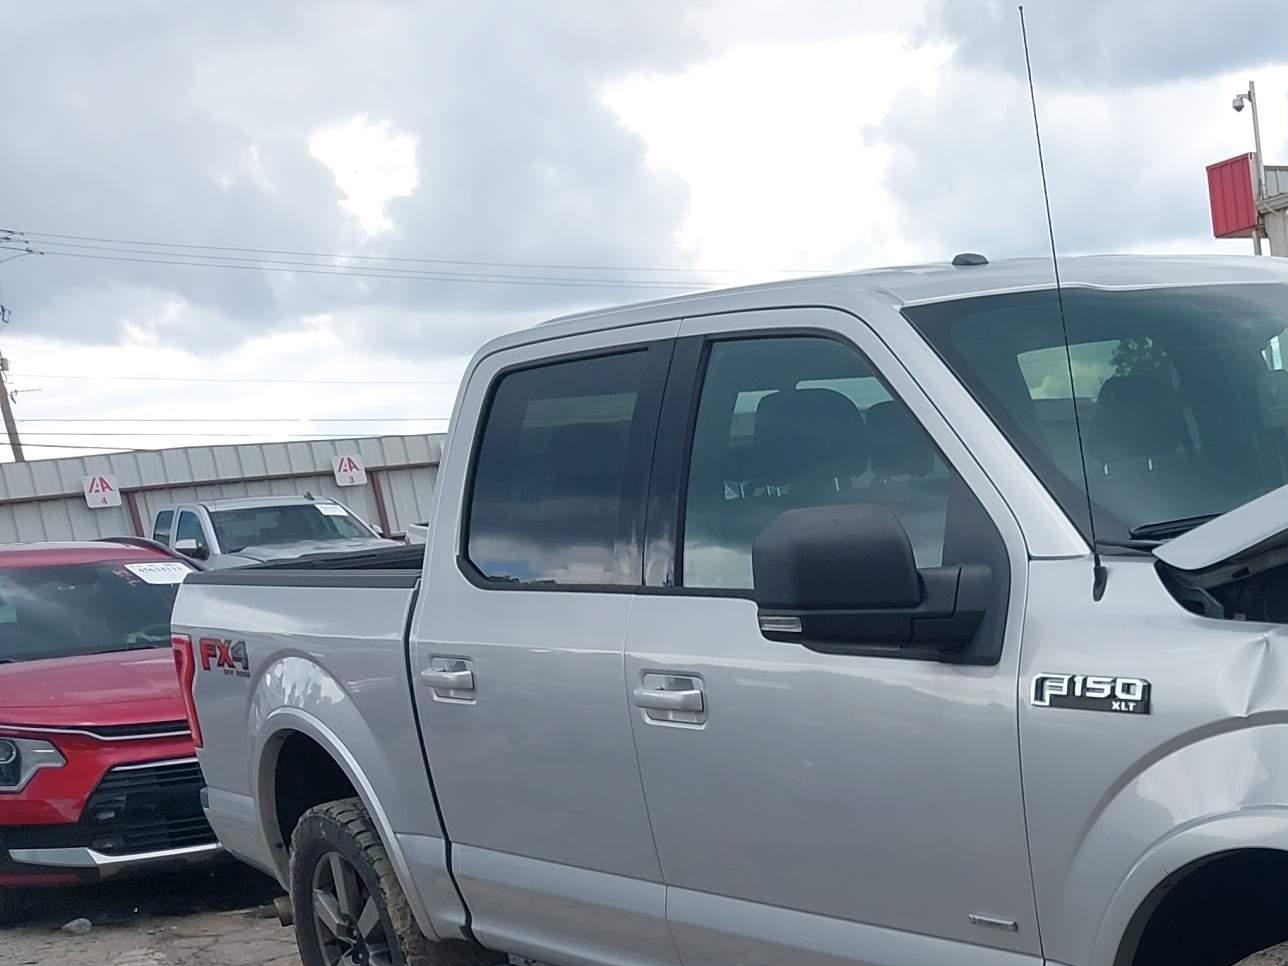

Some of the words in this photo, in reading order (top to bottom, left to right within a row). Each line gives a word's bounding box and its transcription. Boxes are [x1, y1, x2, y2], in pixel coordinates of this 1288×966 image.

[199, 638, 249, 671] FX4
[1031, 672, 1144, 706] F150
[1111, 701, 1136, 711] XLT
